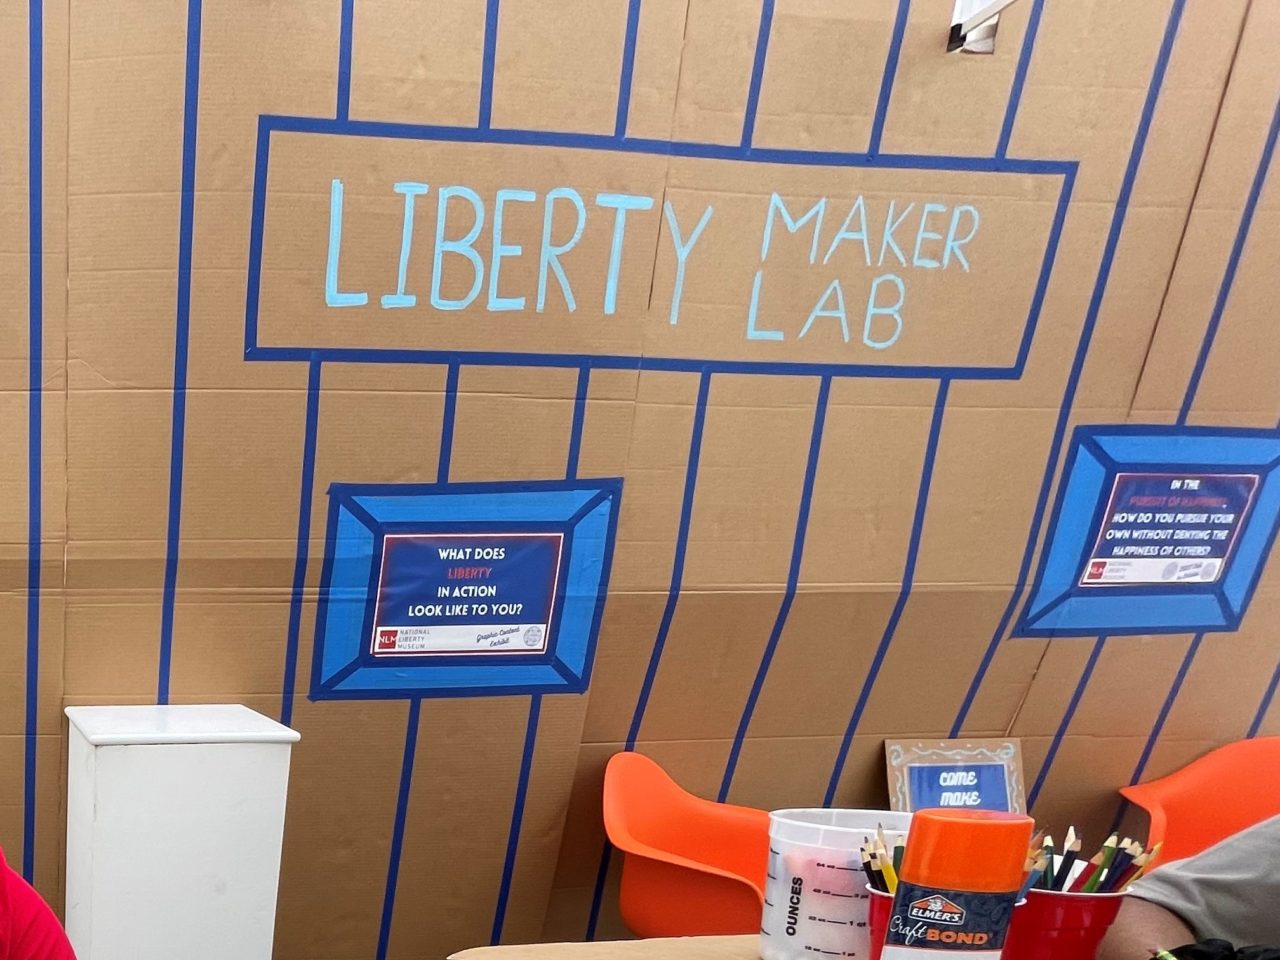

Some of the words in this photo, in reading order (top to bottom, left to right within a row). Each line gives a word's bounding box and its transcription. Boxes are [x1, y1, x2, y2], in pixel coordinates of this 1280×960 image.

[325, 179, 715, 325] LIBERTY
[761, 192, 981, 272] MAKER
[747, 269, 907, 350] LAB
[1112, 513, 1138, 523] HOW
[1138, 513, 1152, 523] DO
[1154, 513, 1175, 523] YOU
[1209, 514, 1235, 524] YOUR
[1106, 530, 1131, 540] OWN
[1132, 530, 1173, 540] WITHOUT
[1212, 530, 1229, 540] THE
[438, 549, 472, 560] WHAT
[474, 548, 505, 560] DOES
[1160, 546, 1174, 556] OF
[448, 568, 493, 580] LIBERTY
[437, 586, 450, 597] IN
[452, 586, 496, 597] ACTION
[408, 605, 442, 616] LOOK
[445, 605, 468, 616] LIKE
[472, 604, 488, 616] TO
[491, 604, 523, 615] YOU?
[786, 876, 803, 936] OUNCES
[911, 907, 962, 922] ELMER'S
